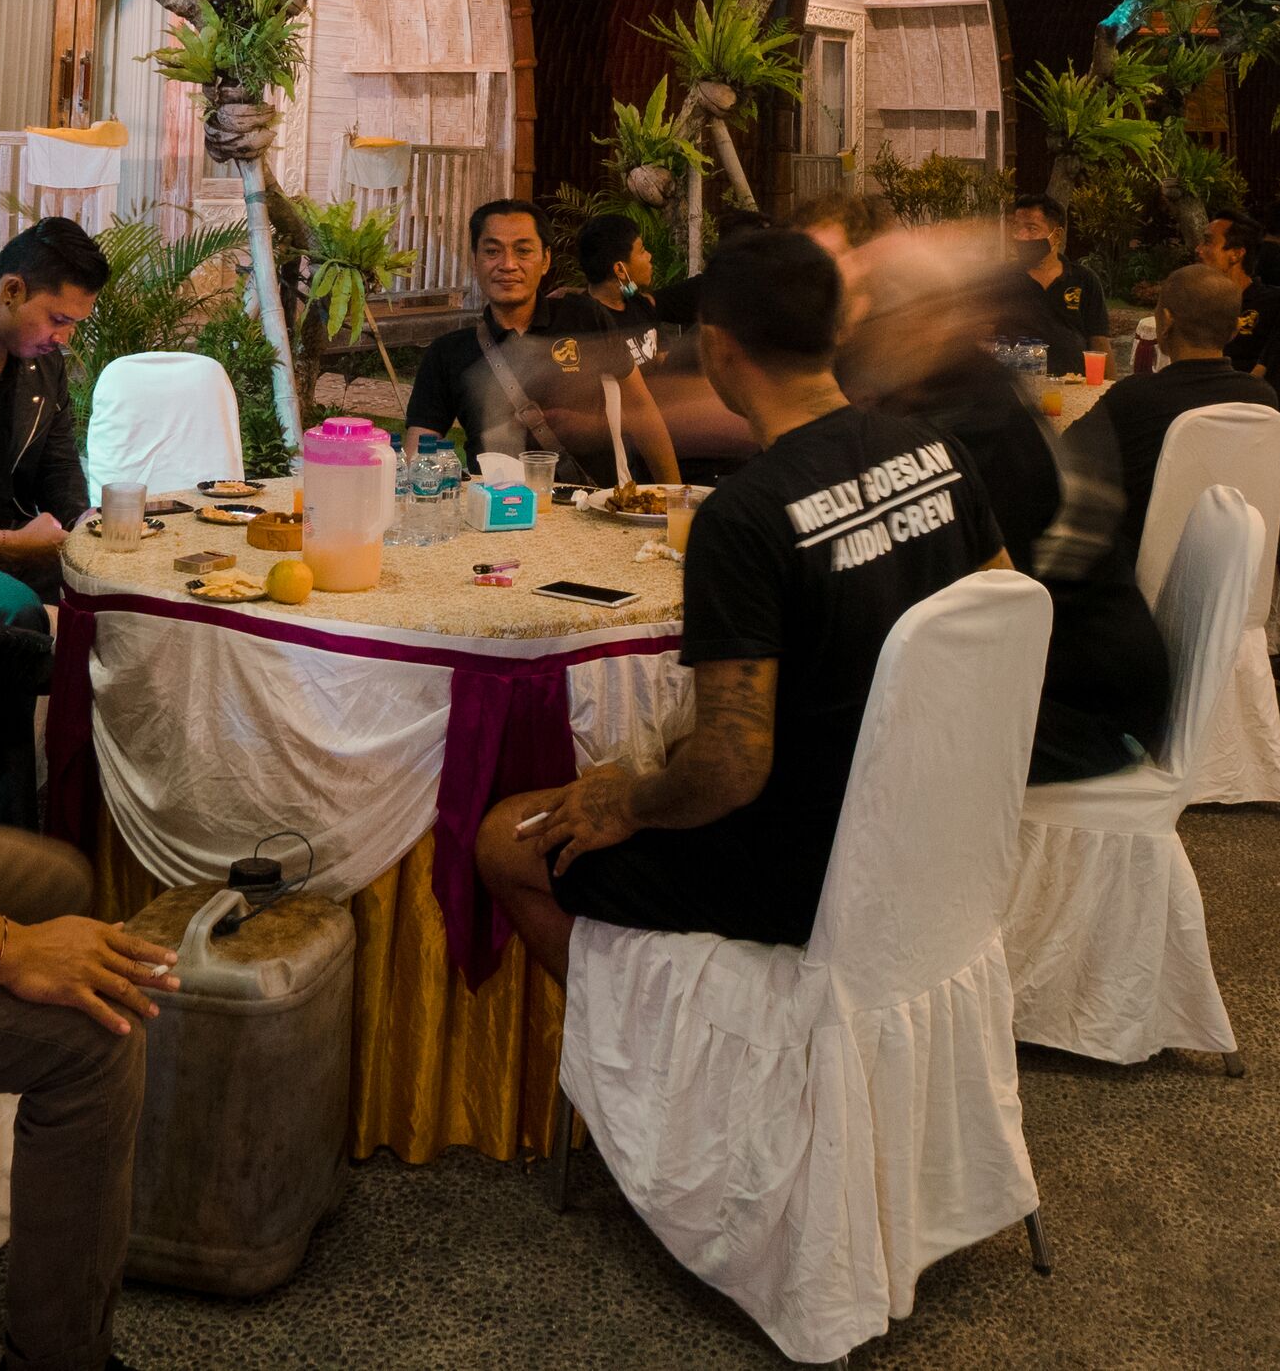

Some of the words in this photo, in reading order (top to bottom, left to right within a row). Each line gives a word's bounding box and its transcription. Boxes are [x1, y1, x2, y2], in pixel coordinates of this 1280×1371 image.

[785, 479, 864, 534] MELLY
[860, 441, 953, 503] GOESLAW
[831, 521, 892, 572] AUDIO
[887, 490, 955, 542] CREW
